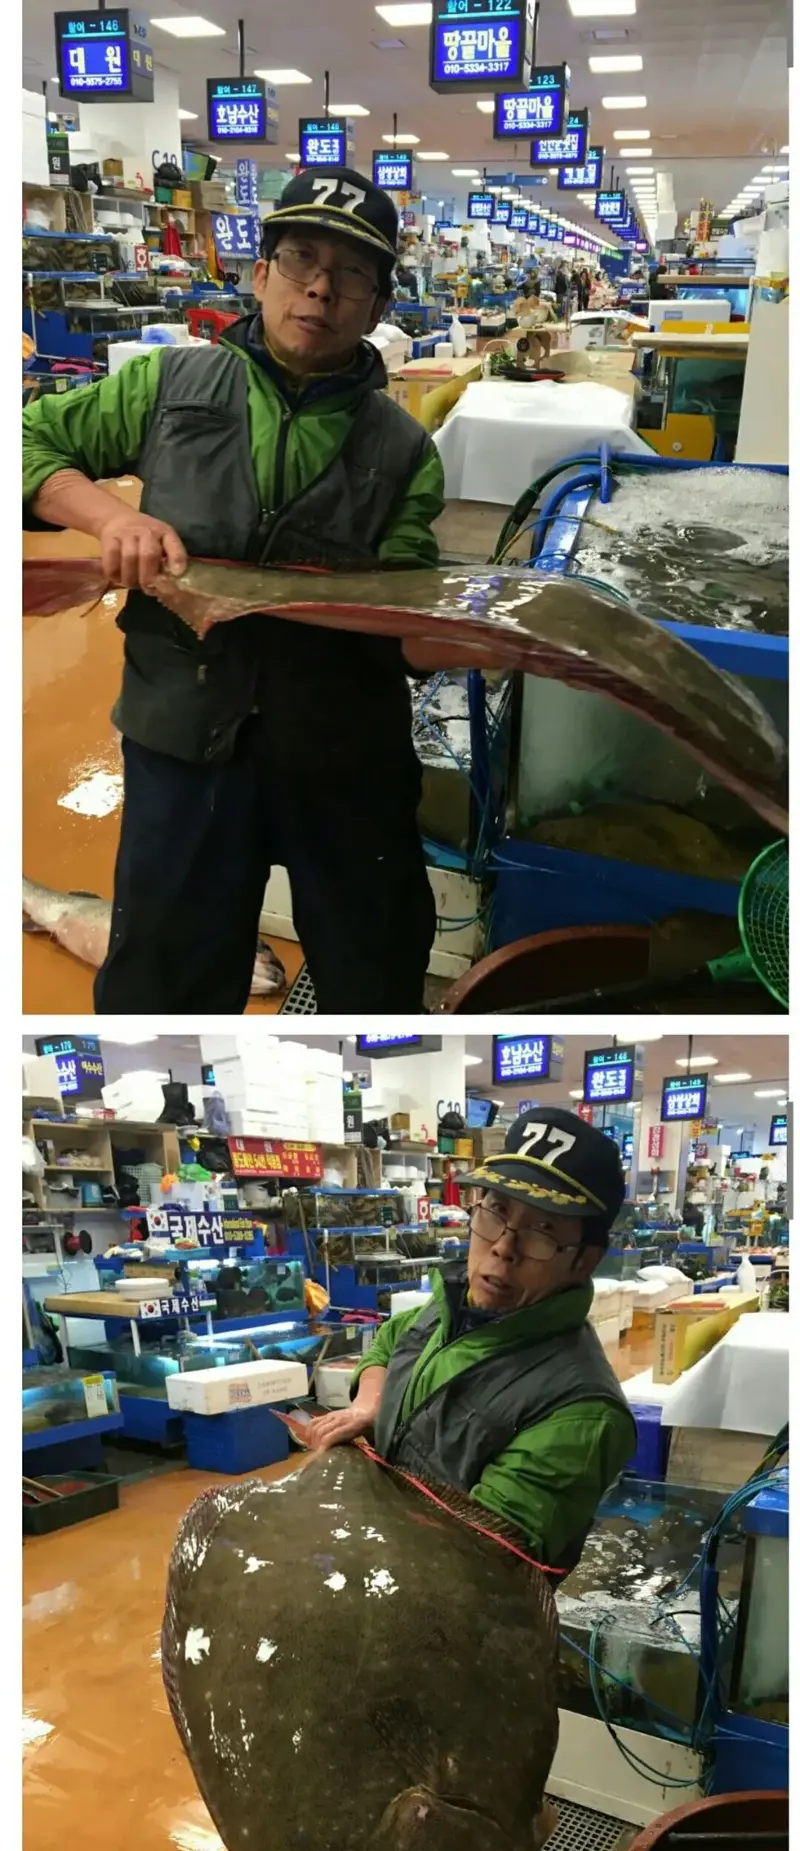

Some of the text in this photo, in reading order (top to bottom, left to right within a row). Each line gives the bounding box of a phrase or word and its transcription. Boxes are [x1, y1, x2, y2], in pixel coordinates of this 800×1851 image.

[488, 0, 512, 10] 122
[99, 20, 119, 32] 146
[443, 26, 512, 60] 땅끝마을
[444, 62, 510, 74] 010-5334-3317
[537, 74, 555, 85] 123
[216, 104, 260, 125] 호남수산
[503, 96, 554, 120] 땅끝마을
[53, 156, 61, 170] 원
[312, 178, 366, 213] 77
[500, 1040, 544, 1065] 호남수산
[517, 1122, 576, 1166] 77
[168, 1215, 224, 1245] 국제수산
[161, 1296, 199, 1315] 국제수산
